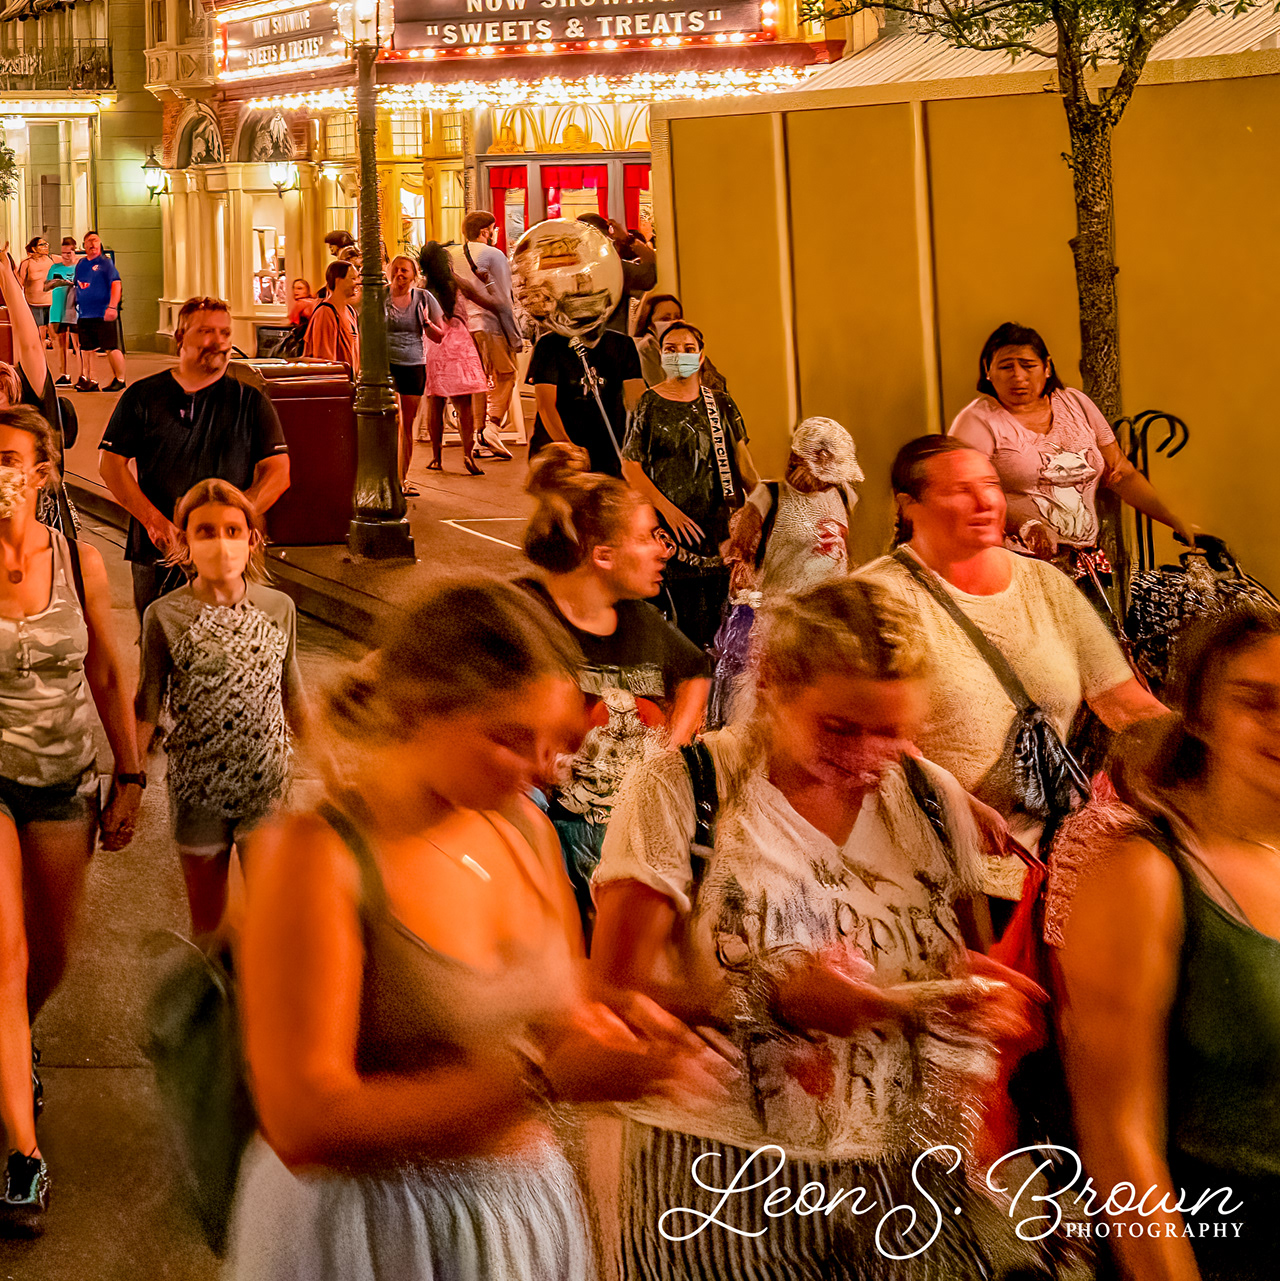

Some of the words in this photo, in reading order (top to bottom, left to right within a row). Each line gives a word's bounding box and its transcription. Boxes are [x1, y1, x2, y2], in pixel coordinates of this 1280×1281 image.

[426, 20, 552, 45] "SWEETS
[565, 18, 585, 38] &
[597, 9, 722, 38] TREATS"
